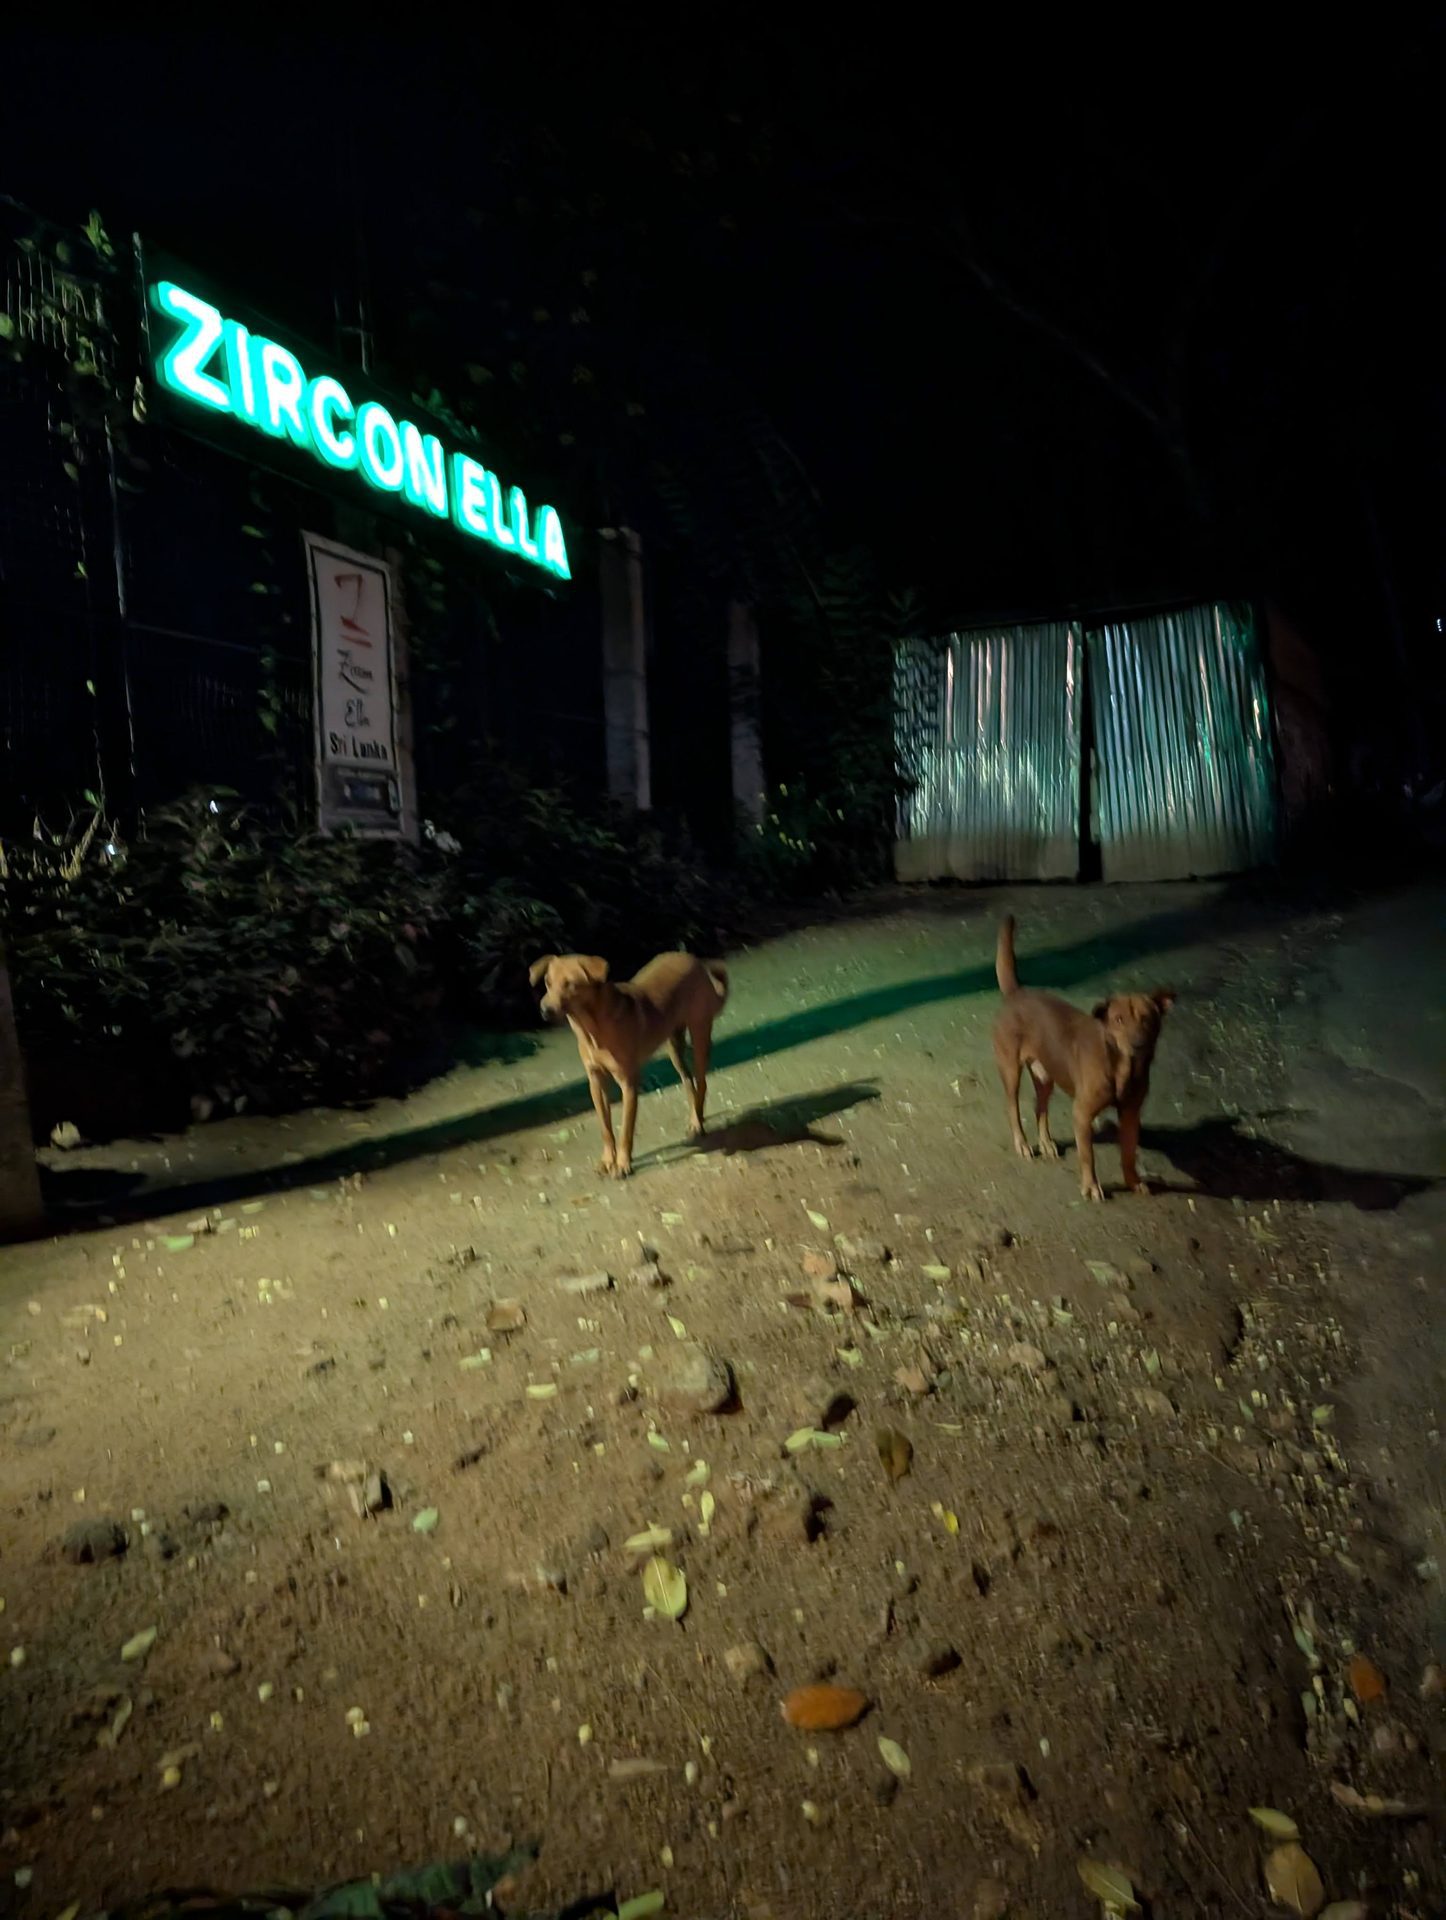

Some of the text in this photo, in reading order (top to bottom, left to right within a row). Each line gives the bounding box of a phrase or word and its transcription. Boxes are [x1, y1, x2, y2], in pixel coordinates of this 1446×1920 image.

[157, 281, 571, 579] ZIRCON ELLA
[330, 731, 388, 760] Sri Lanka
